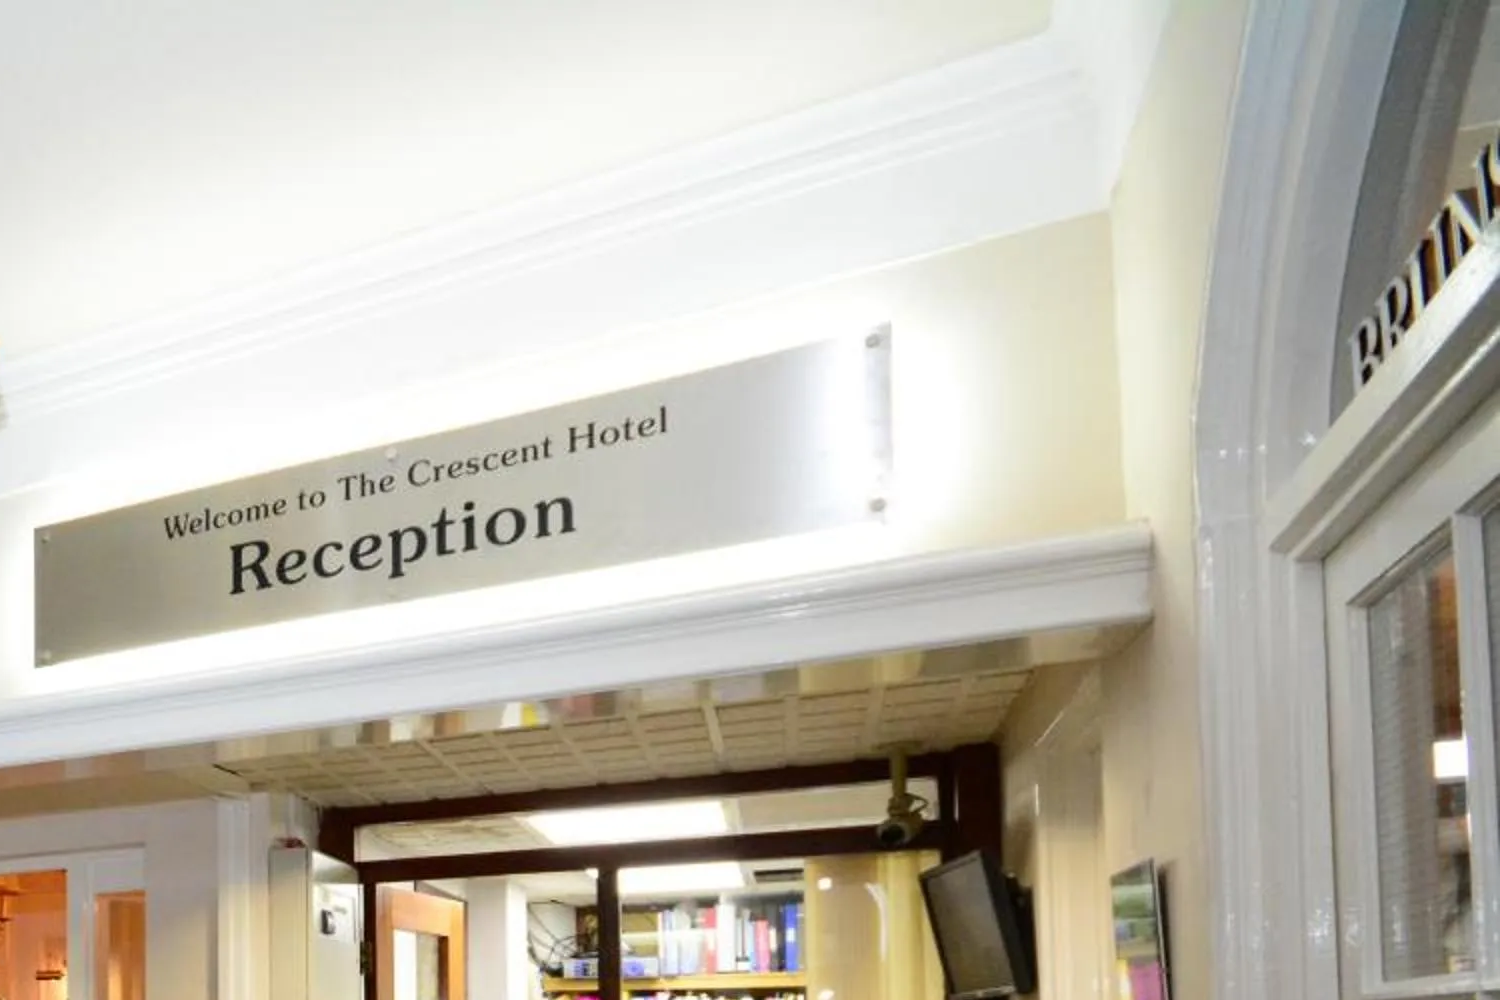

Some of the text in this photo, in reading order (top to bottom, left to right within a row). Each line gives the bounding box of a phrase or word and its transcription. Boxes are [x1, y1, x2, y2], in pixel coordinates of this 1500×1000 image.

[163, 405, 667, 540] Welcome to The Crescent Hotel
[229, 497, 576, 595] Reception
